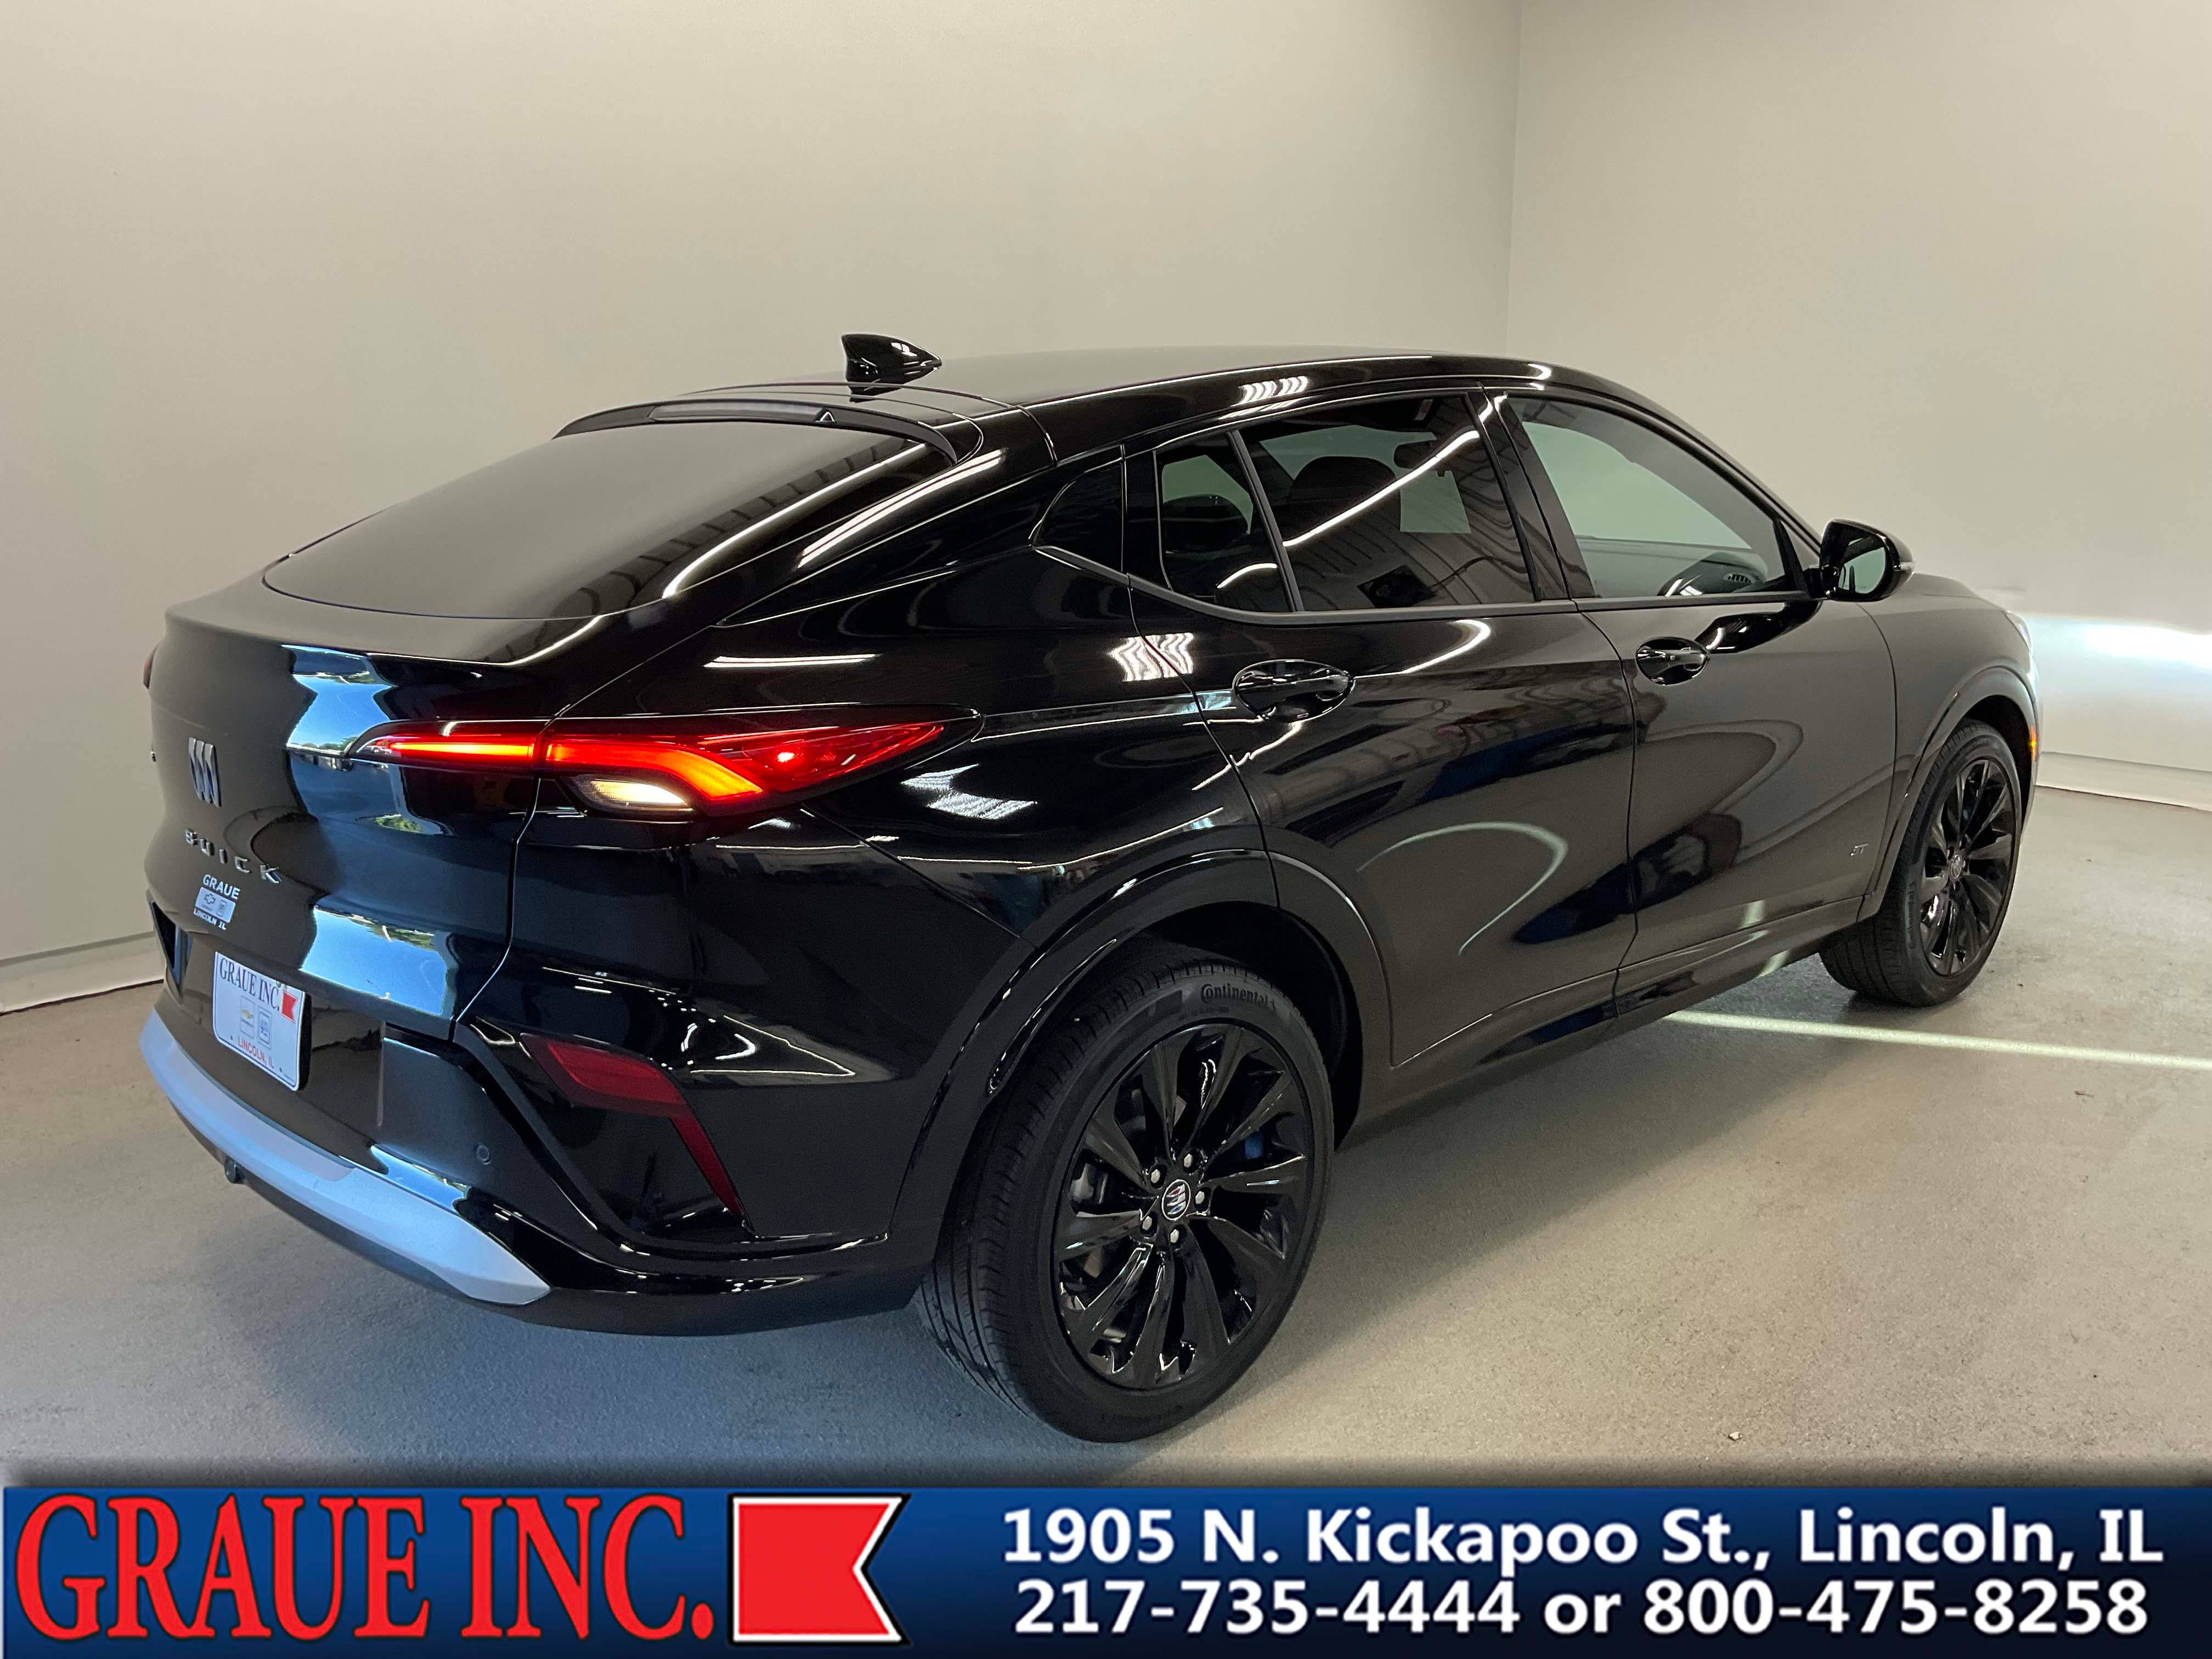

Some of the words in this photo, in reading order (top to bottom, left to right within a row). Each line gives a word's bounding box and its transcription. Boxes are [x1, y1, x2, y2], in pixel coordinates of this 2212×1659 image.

[185, 829, 282, 883] BUICK
[203, 874, 240, 900] GRAUE
[193, 909, 217, 926] LINCOLN
[218, 922, 227, 930] IL
[219, 957, 257, 996] GRAUE
[259, 974, 280, 1011] INC.
[1200, 983, 1269, 1007] Continental
[238, 1036, 267, 1065] LINCOLN,
[268, 1056, 274, 1069] IL
